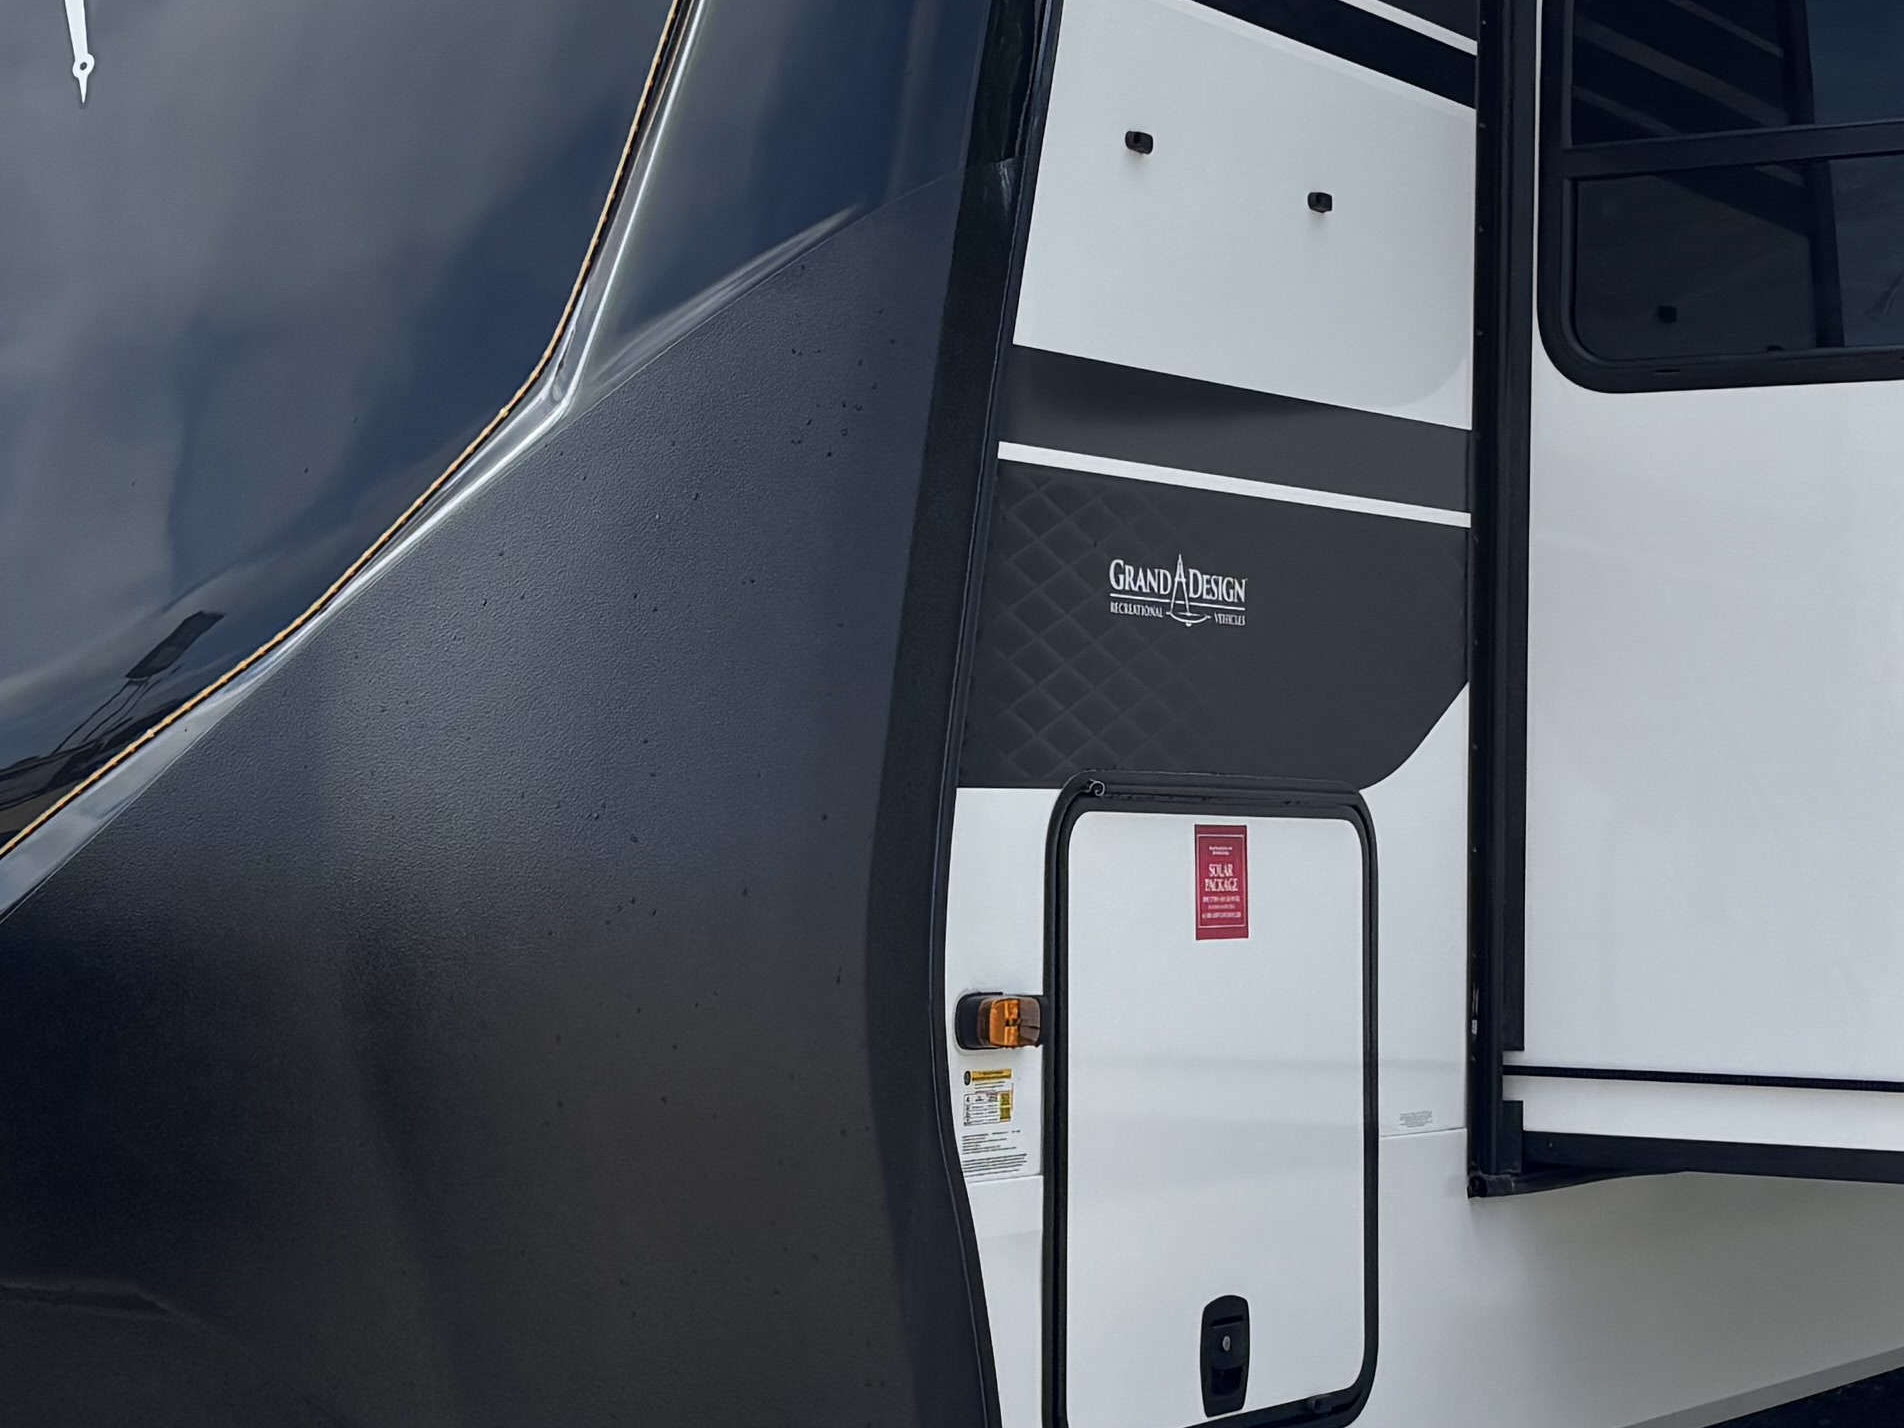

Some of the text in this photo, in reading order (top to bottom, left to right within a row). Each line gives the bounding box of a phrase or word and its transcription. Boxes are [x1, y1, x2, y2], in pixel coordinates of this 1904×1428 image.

[1109, 559, 1245, 603] GRAND DESIGN
[1208, 863, 1234, 878] SOLAR
[1204, 878, 1239, 893] PACKAGE
